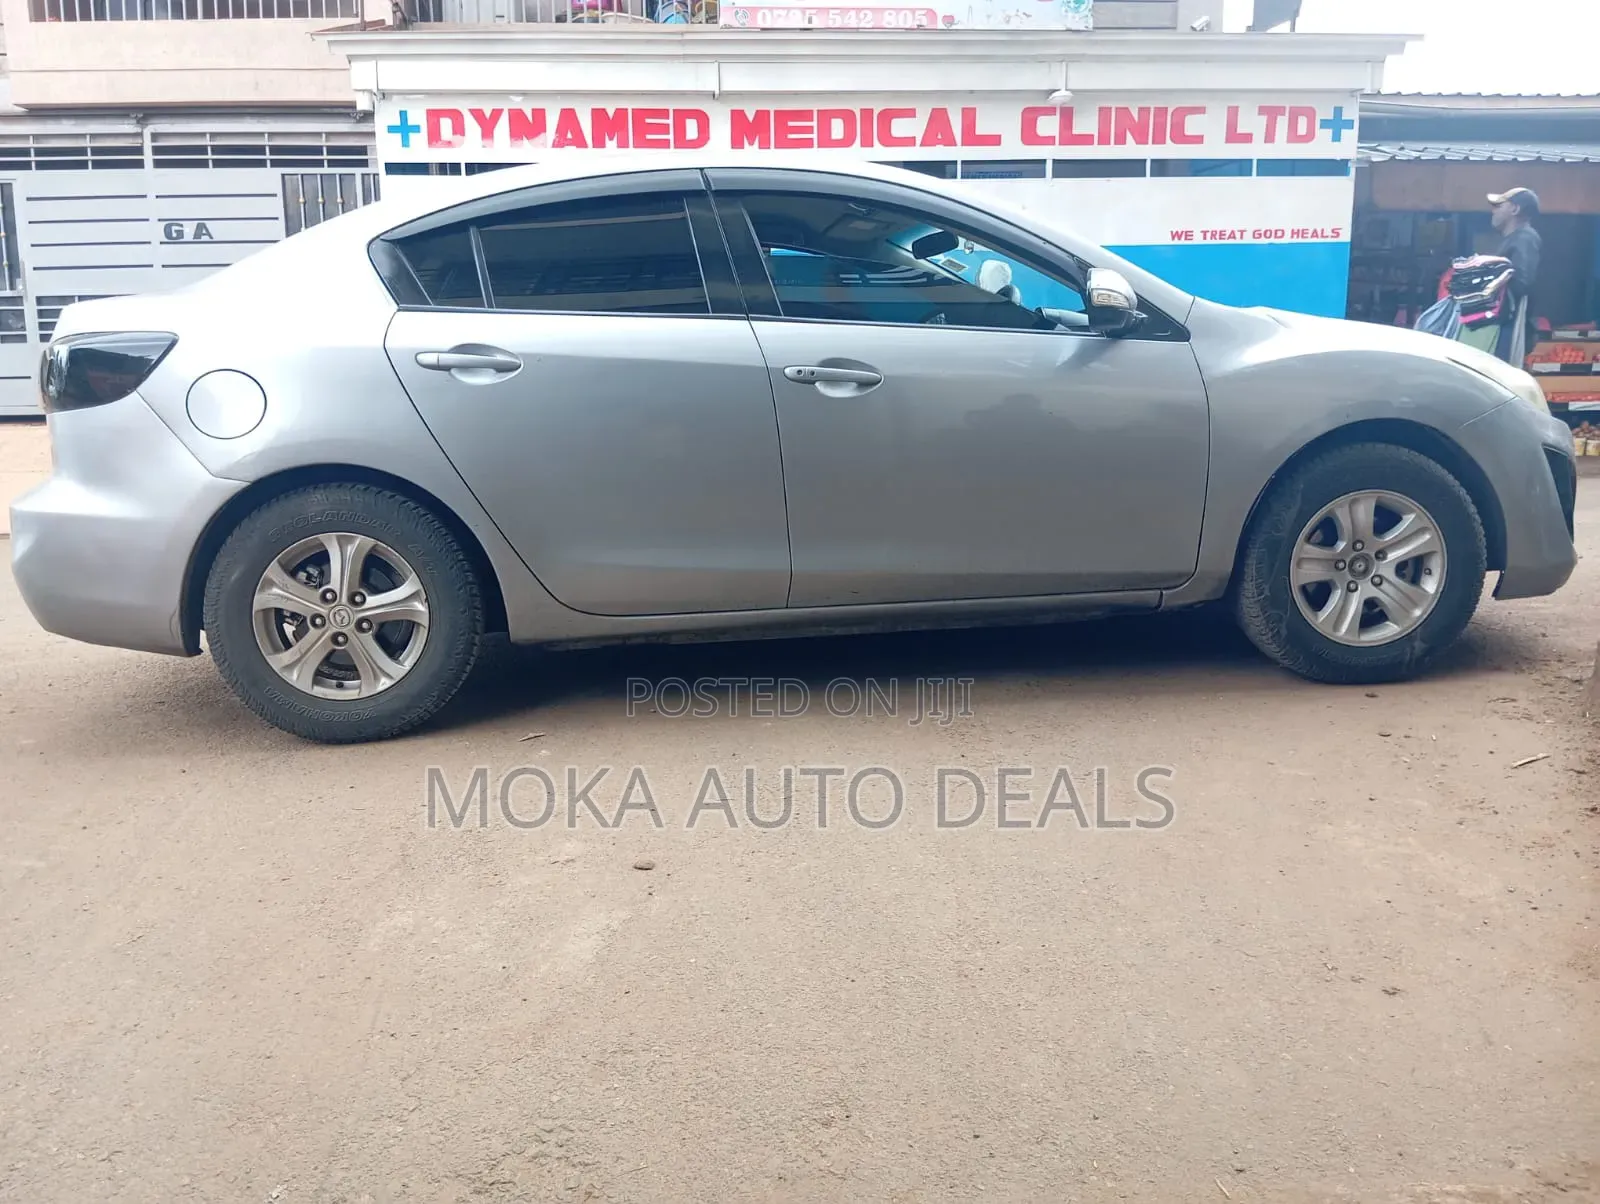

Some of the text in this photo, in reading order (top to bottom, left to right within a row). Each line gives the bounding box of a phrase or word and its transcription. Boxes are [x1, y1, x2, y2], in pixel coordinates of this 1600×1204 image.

[828, 9, 875, 28] 542
[882, 9, 928, 28] 805
[426, 105, 1316, 149] DYNAMED MEDICAL CLINIC LTD
[1170, 227, 1342, 241] WE TREAT GOD HEALS
